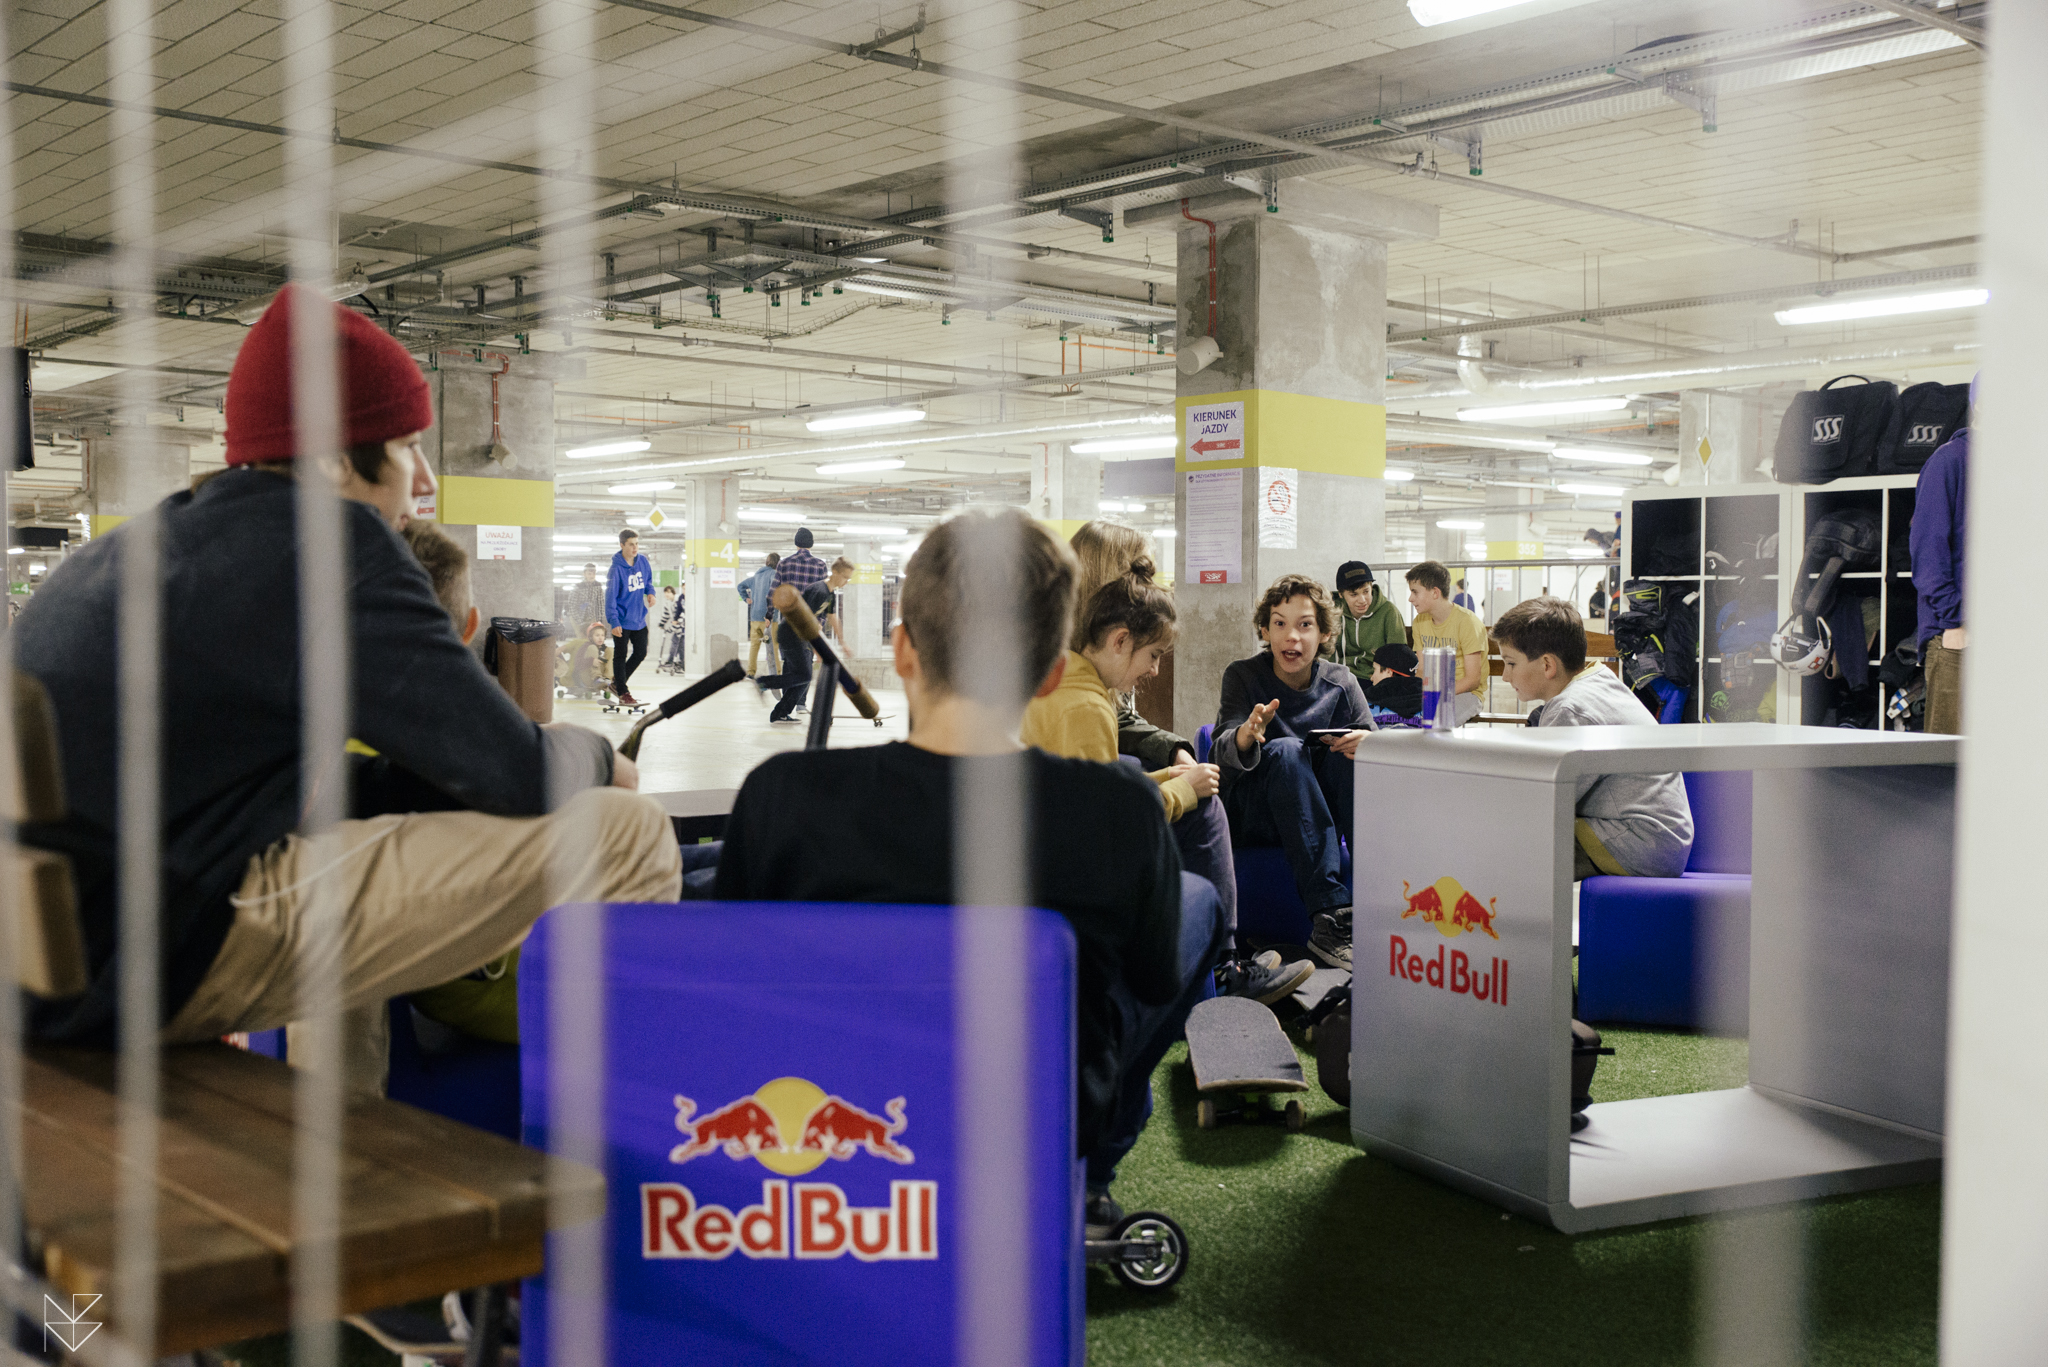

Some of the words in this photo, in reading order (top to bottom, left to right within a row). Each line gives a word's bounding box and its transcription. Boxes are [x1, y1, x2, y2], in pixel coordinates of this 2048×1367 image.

[1193, 409, 1237, 422] KIERUNEK
[1813, 418, 1842, 441] SSS
[1907, 425, 1942, 442] SSS
[485, 531, 514, 539] UWAŻAJ
[711, 543, 735, 563] -4
[1518, 543, 1536, 556] 352
[1390, 934, 1445, 990] Red
[1450, 949, 1508, 1007] Bull
[642, 1180, 788, 1259] Red
[794, 1180, 937, 1260] Bull
